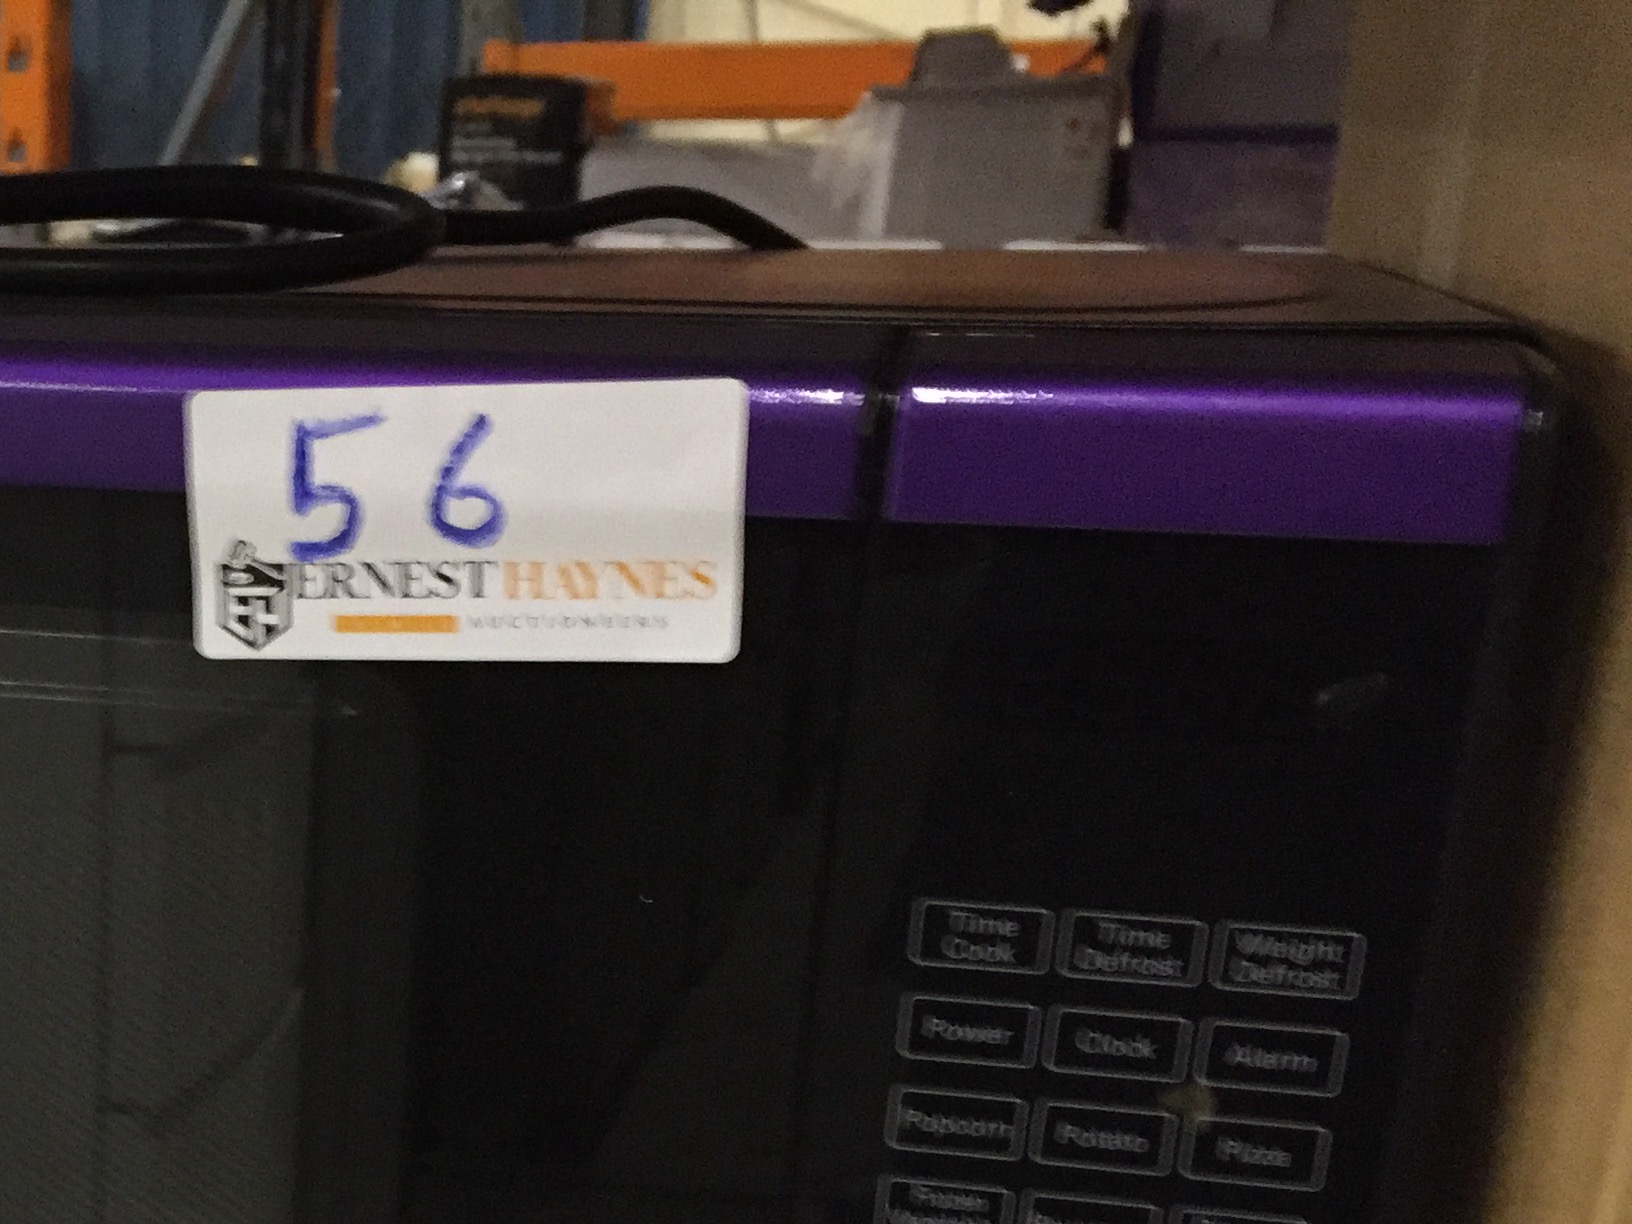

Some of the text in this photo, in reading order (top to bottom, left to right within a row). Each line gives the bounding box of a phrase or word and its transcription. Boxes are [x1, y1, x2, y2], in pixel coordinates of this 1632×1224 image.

[949, 910, 1021, 937] Time
[1097, 919, 1173, 950] Time
[941, 935, 1016, 964] Cook
[1075, 945, 1184, 979] Defrost
[1235, 927, 1347, 964] Weight
[1229, 957, 1342, 990] Defrost
[921, 1013, 1014, 1046] Power
[1073, 1027, 1158, 1060] Clock
[1224, 1038, 1320, 1073] Alarm
